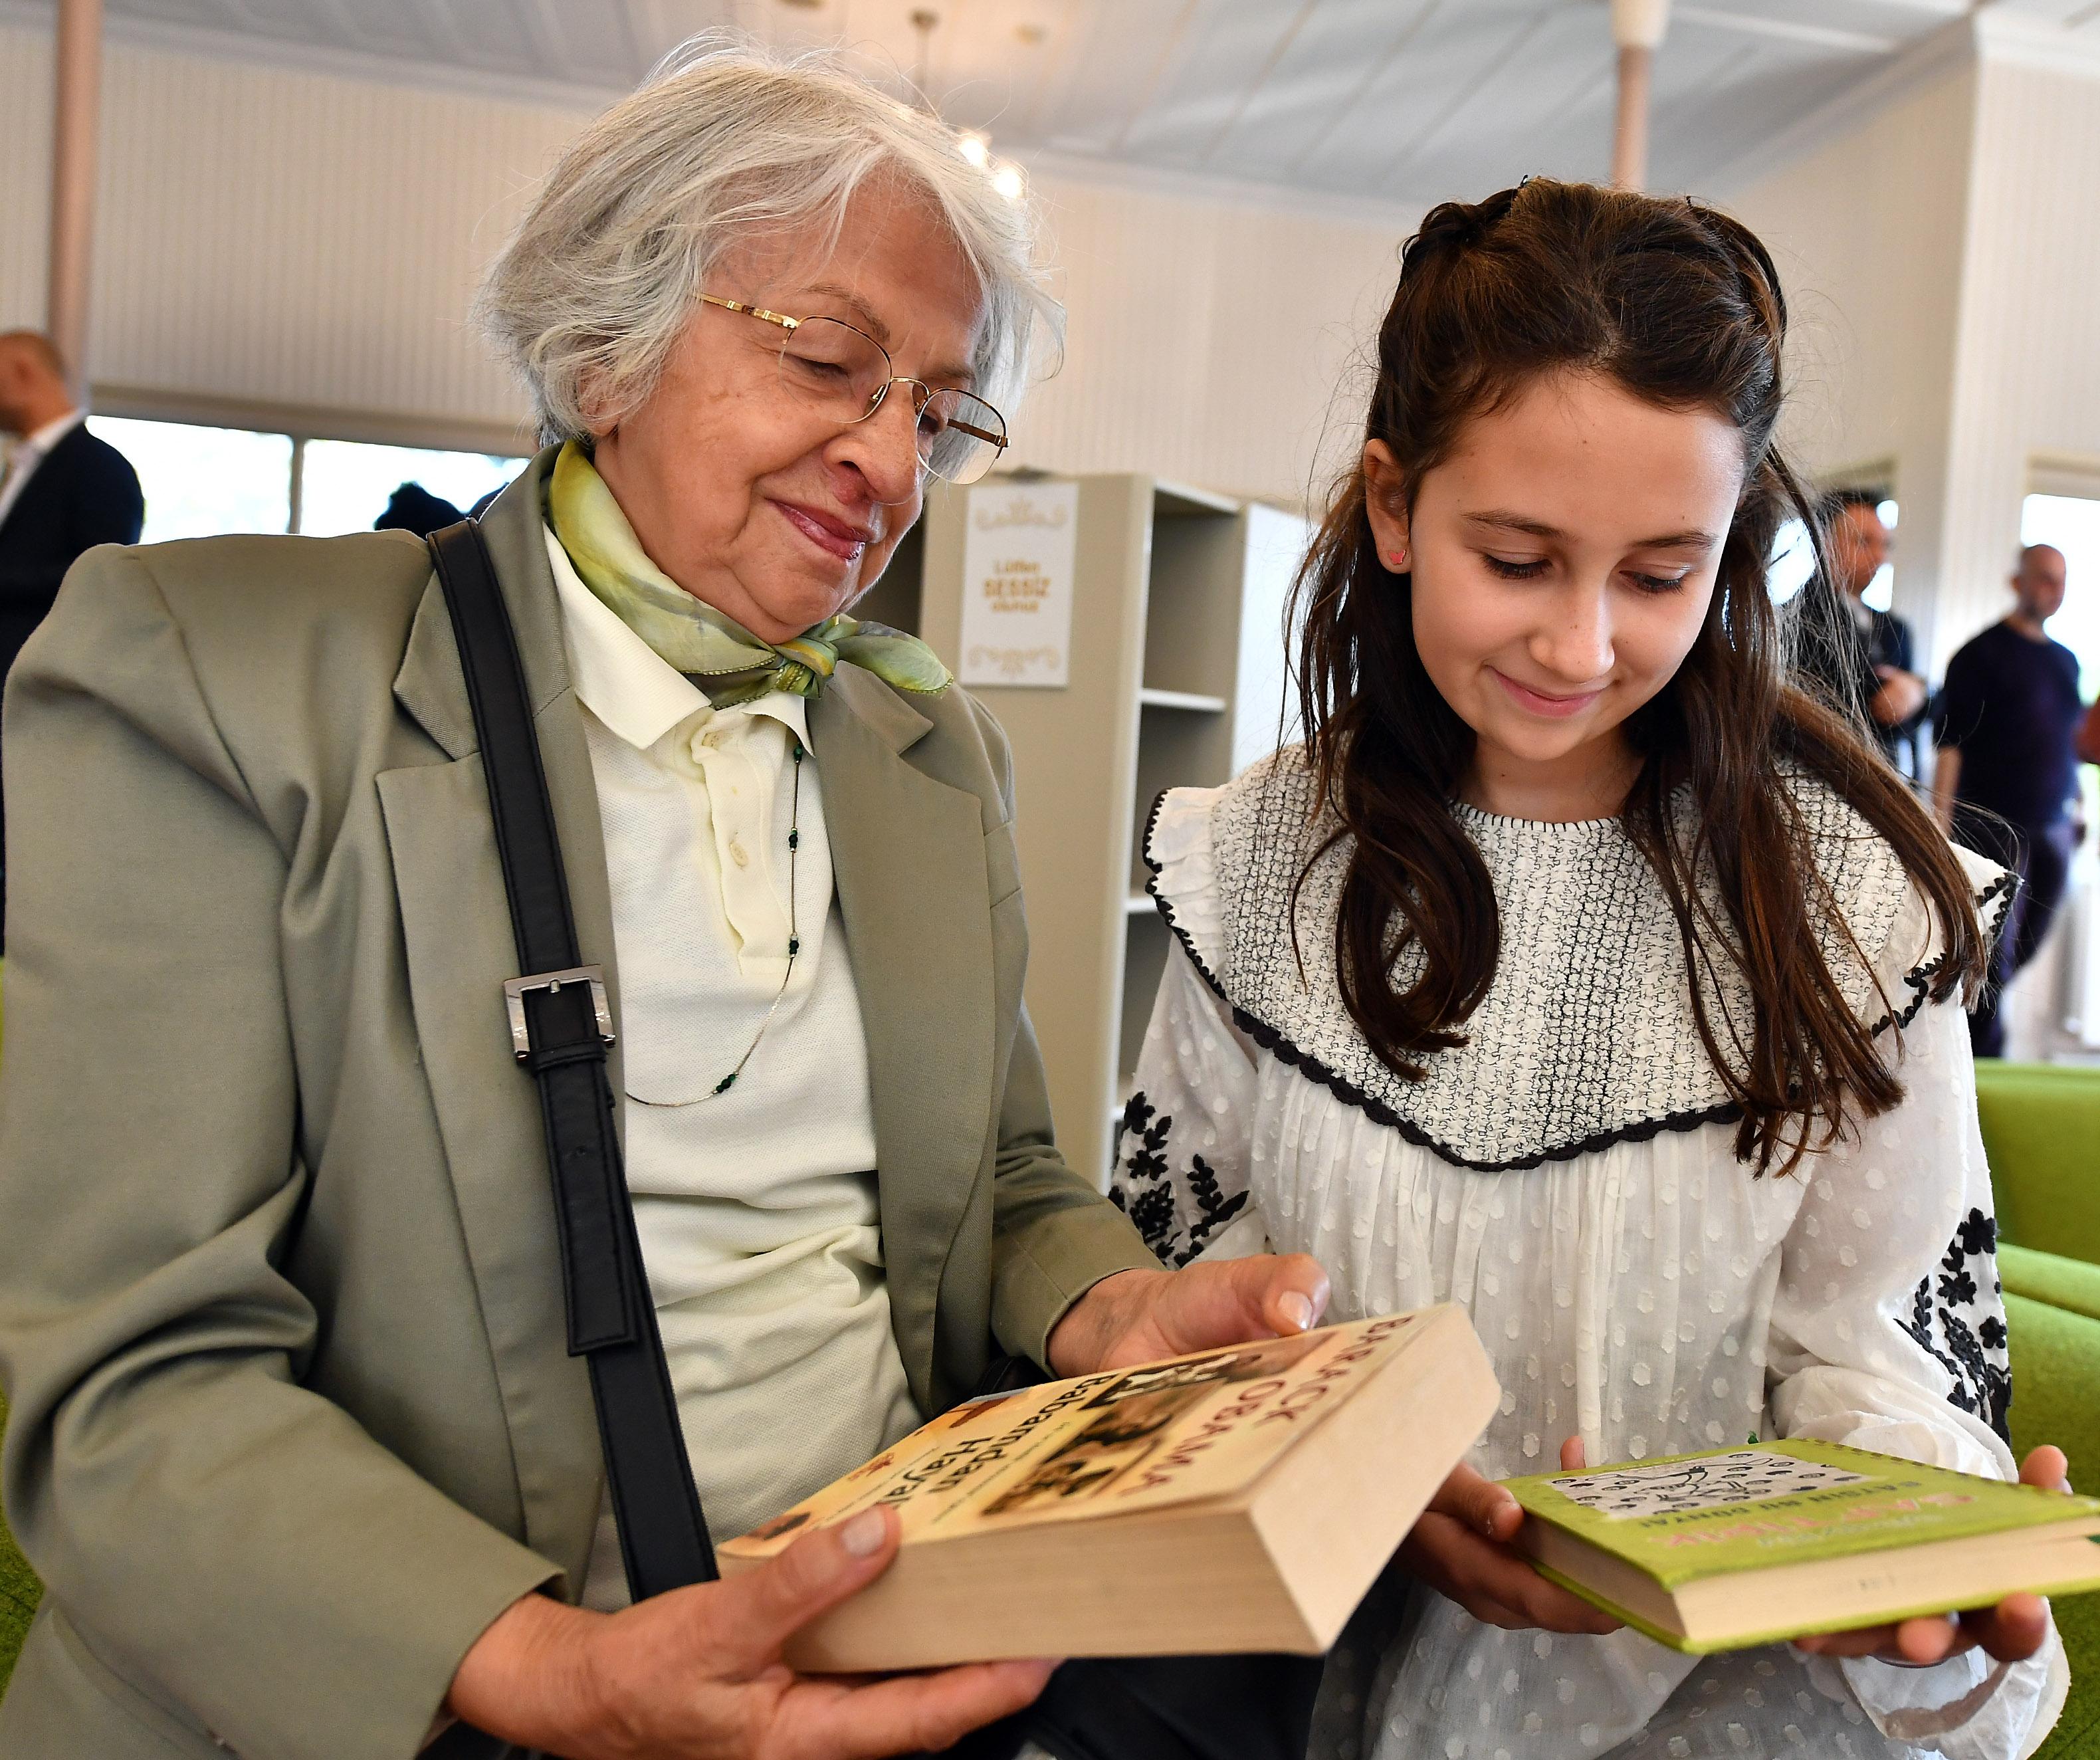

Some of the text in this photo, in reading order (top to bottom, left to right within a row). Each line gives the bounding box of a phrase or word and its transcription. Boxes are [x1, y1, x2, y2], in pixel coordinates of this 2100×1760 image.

[1254, 1314, 1416, 1427] BARACK
[926, 1372, 1118, 1493] Babamdan
[1116, 1378, 1287, 1498] OBAMA
